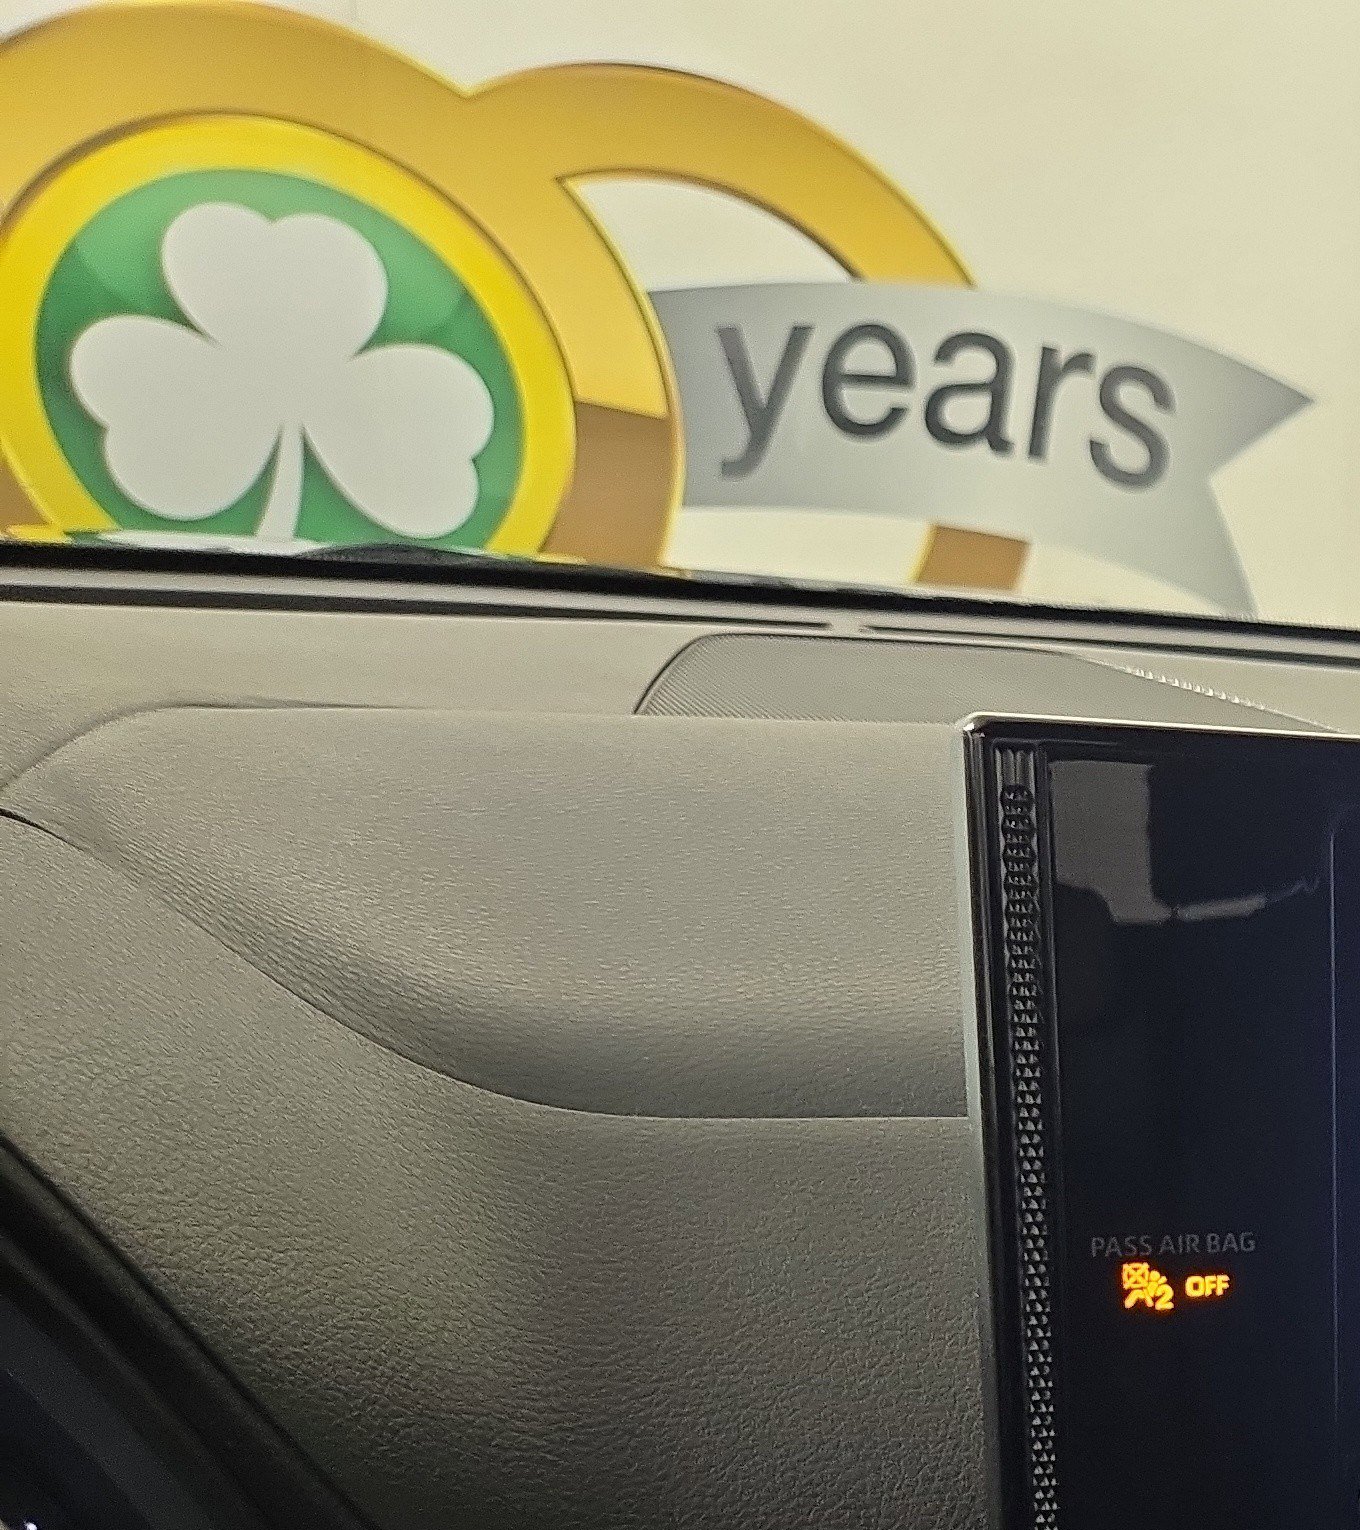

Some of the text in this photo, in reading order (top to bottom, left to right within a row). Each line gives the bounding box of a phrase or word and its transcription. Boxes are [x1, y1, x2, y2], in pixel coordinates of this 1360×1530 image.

[716, 316, 1177, 492] years
[1091, 1231, 1257, 1258] PASS AIR BAG
[1184, 1273, 1231, 1299] OFF
